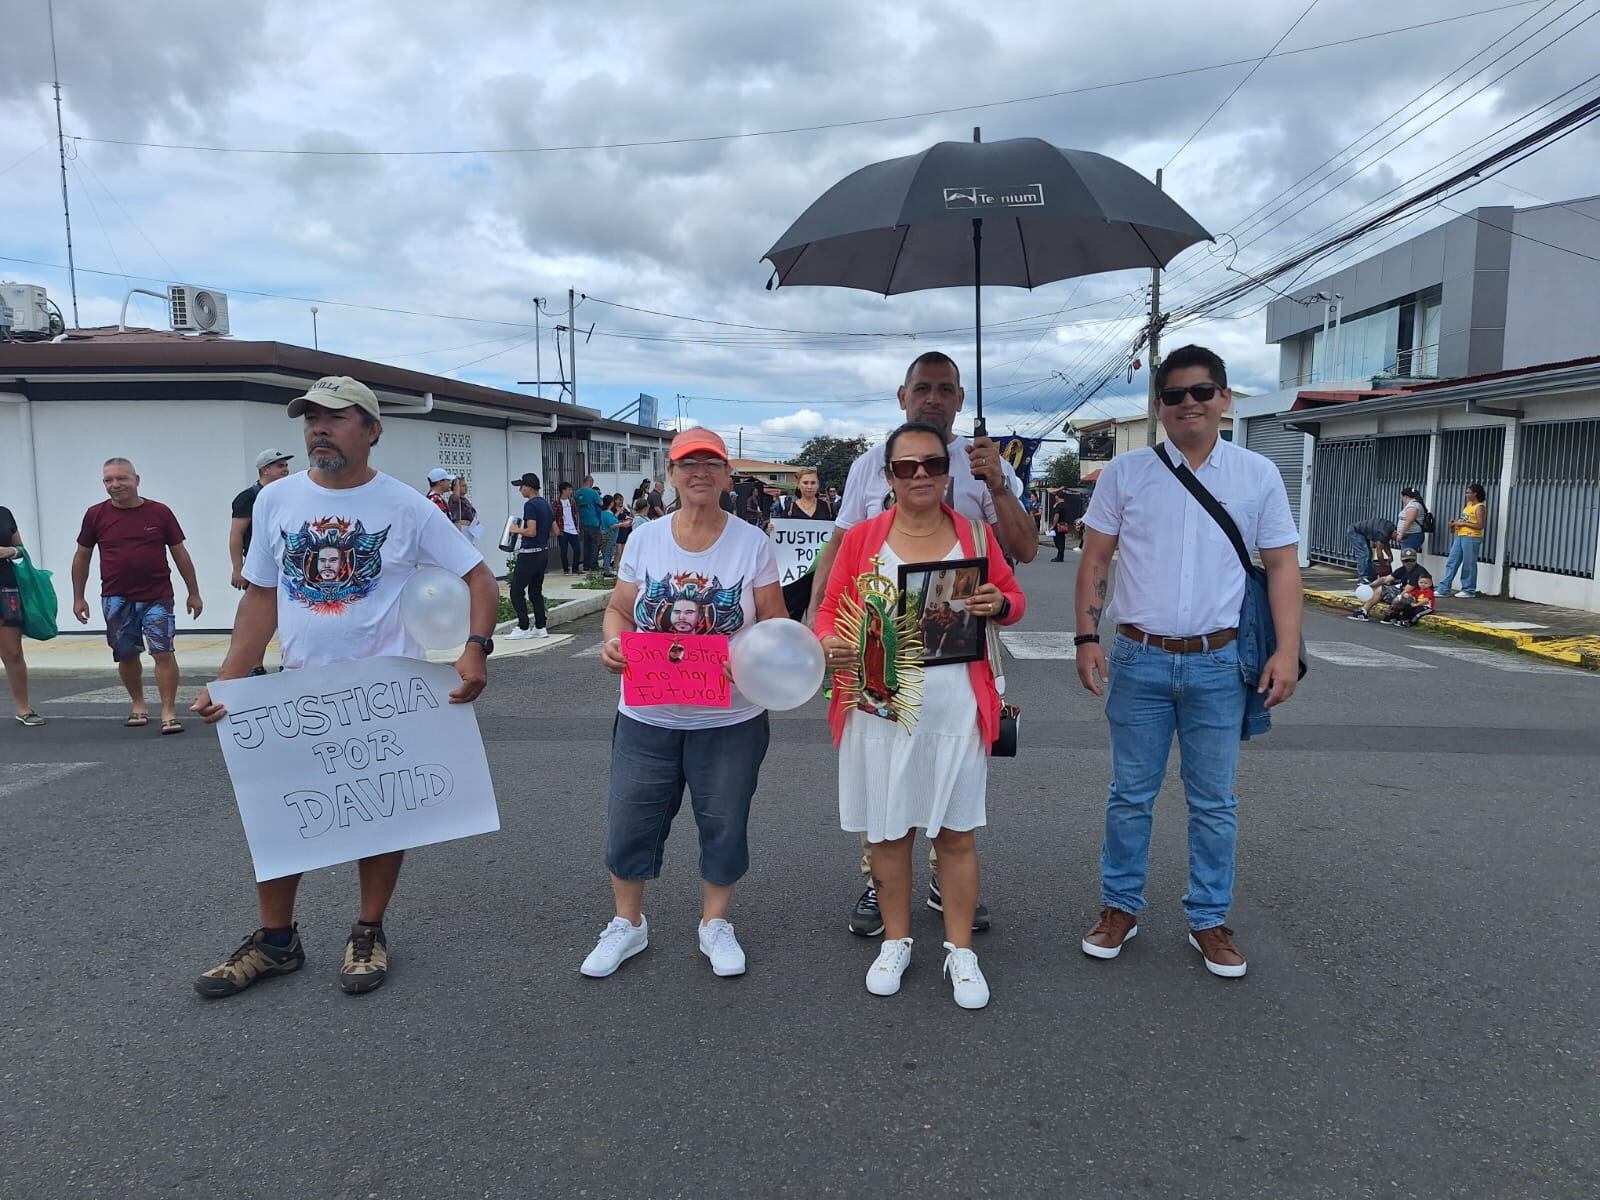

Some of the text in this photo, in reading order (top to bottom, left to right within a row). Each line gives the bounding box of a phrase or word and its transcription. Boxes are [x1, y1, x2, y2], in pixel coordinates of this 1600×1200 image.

[978, 193, 1038, 205] Tenium
[775, 530, 831, 544] JUSTIC
[626, 638, 664, 662] Sin
[677, 666, 707, 688] hay
[229, 677, 439, 749] JUSTICIA
[312, 729, 404, 775] POR
[283, 763, 454, 839] DAVID
